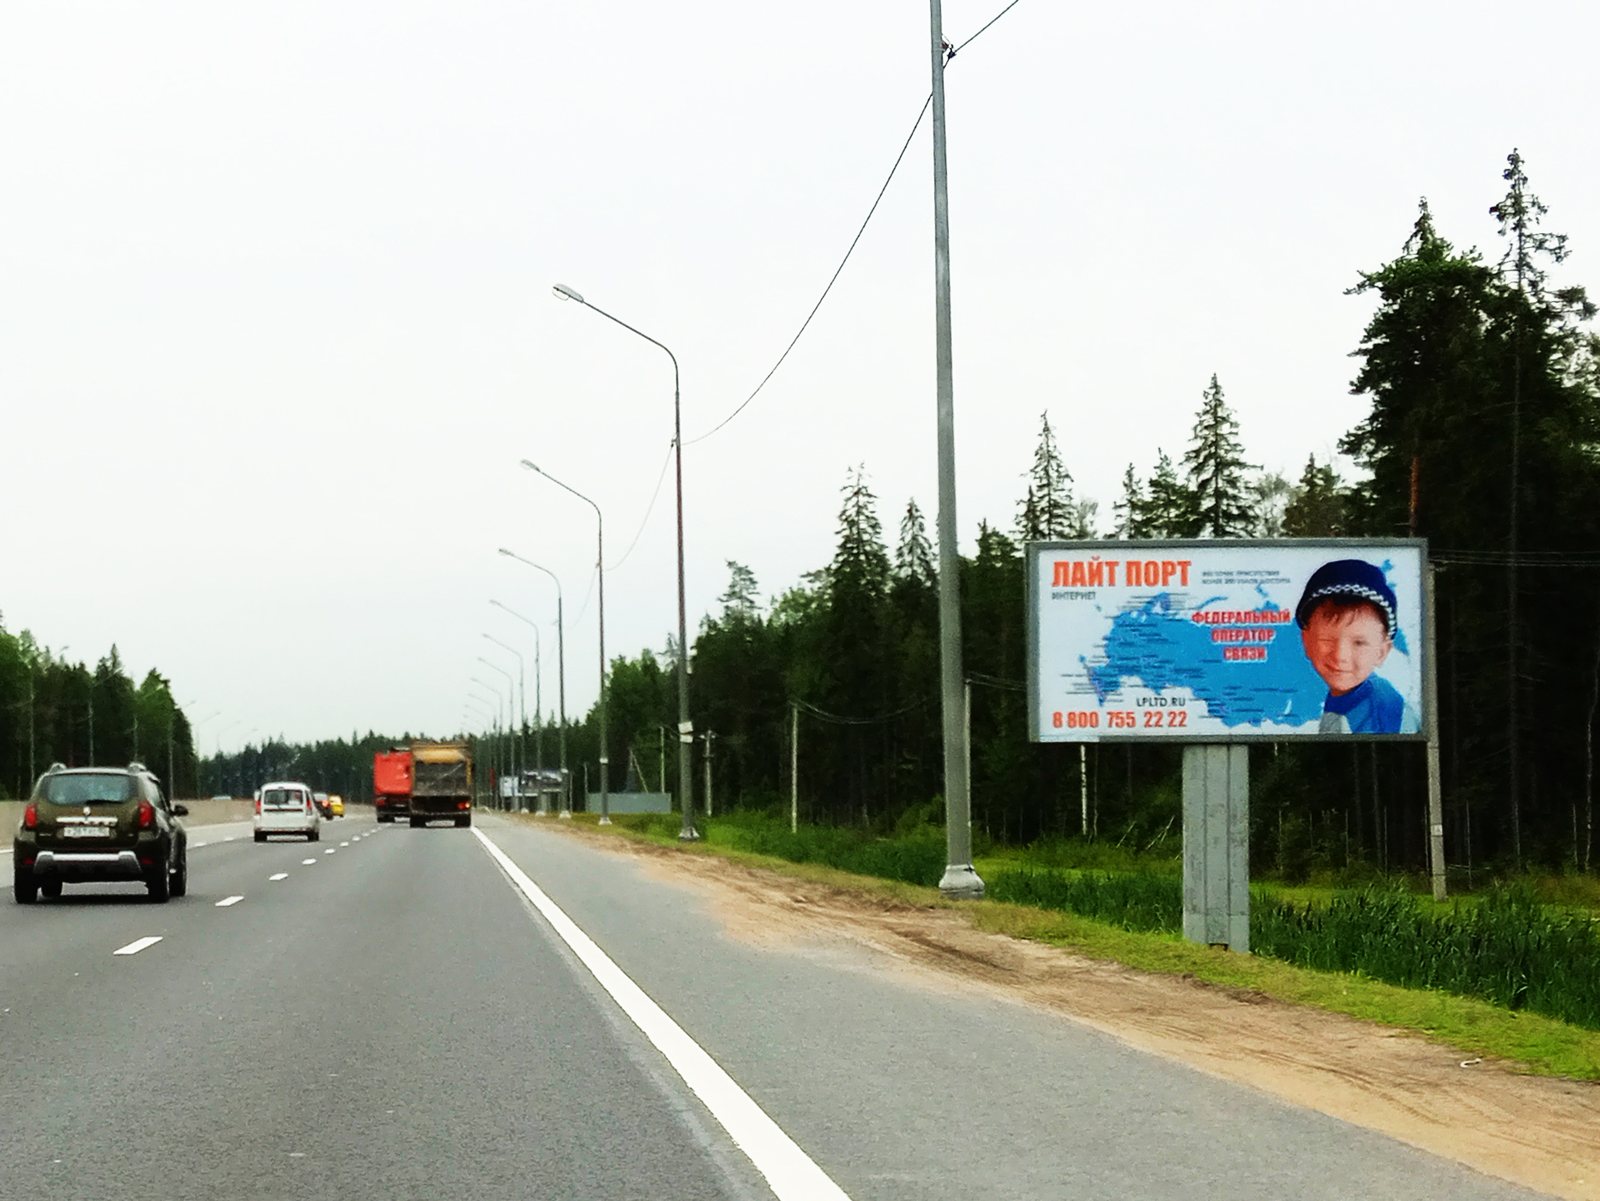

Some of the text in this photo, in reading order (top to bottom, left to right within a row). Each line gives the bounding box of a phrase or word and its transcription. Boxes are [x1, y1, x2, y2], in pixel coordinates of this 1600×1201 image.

[1051, 555, 1192, 587] ЛАЙТ ПОРТ
[1051, 591, 1096, 600] ИНТЕРНЕТ
[1192, 609, 1291, 624] ФЕДЕРАЛЬНЫЙ
[1212, 628, 1275, 642] ОПЕРАТОР
[1224, 646, 1266, 660] СВЯЗИ
[1136, 697, 1186, 707] LPLTD.RU
[1052, 711, 1188, 728] 8 800 755 22 22
